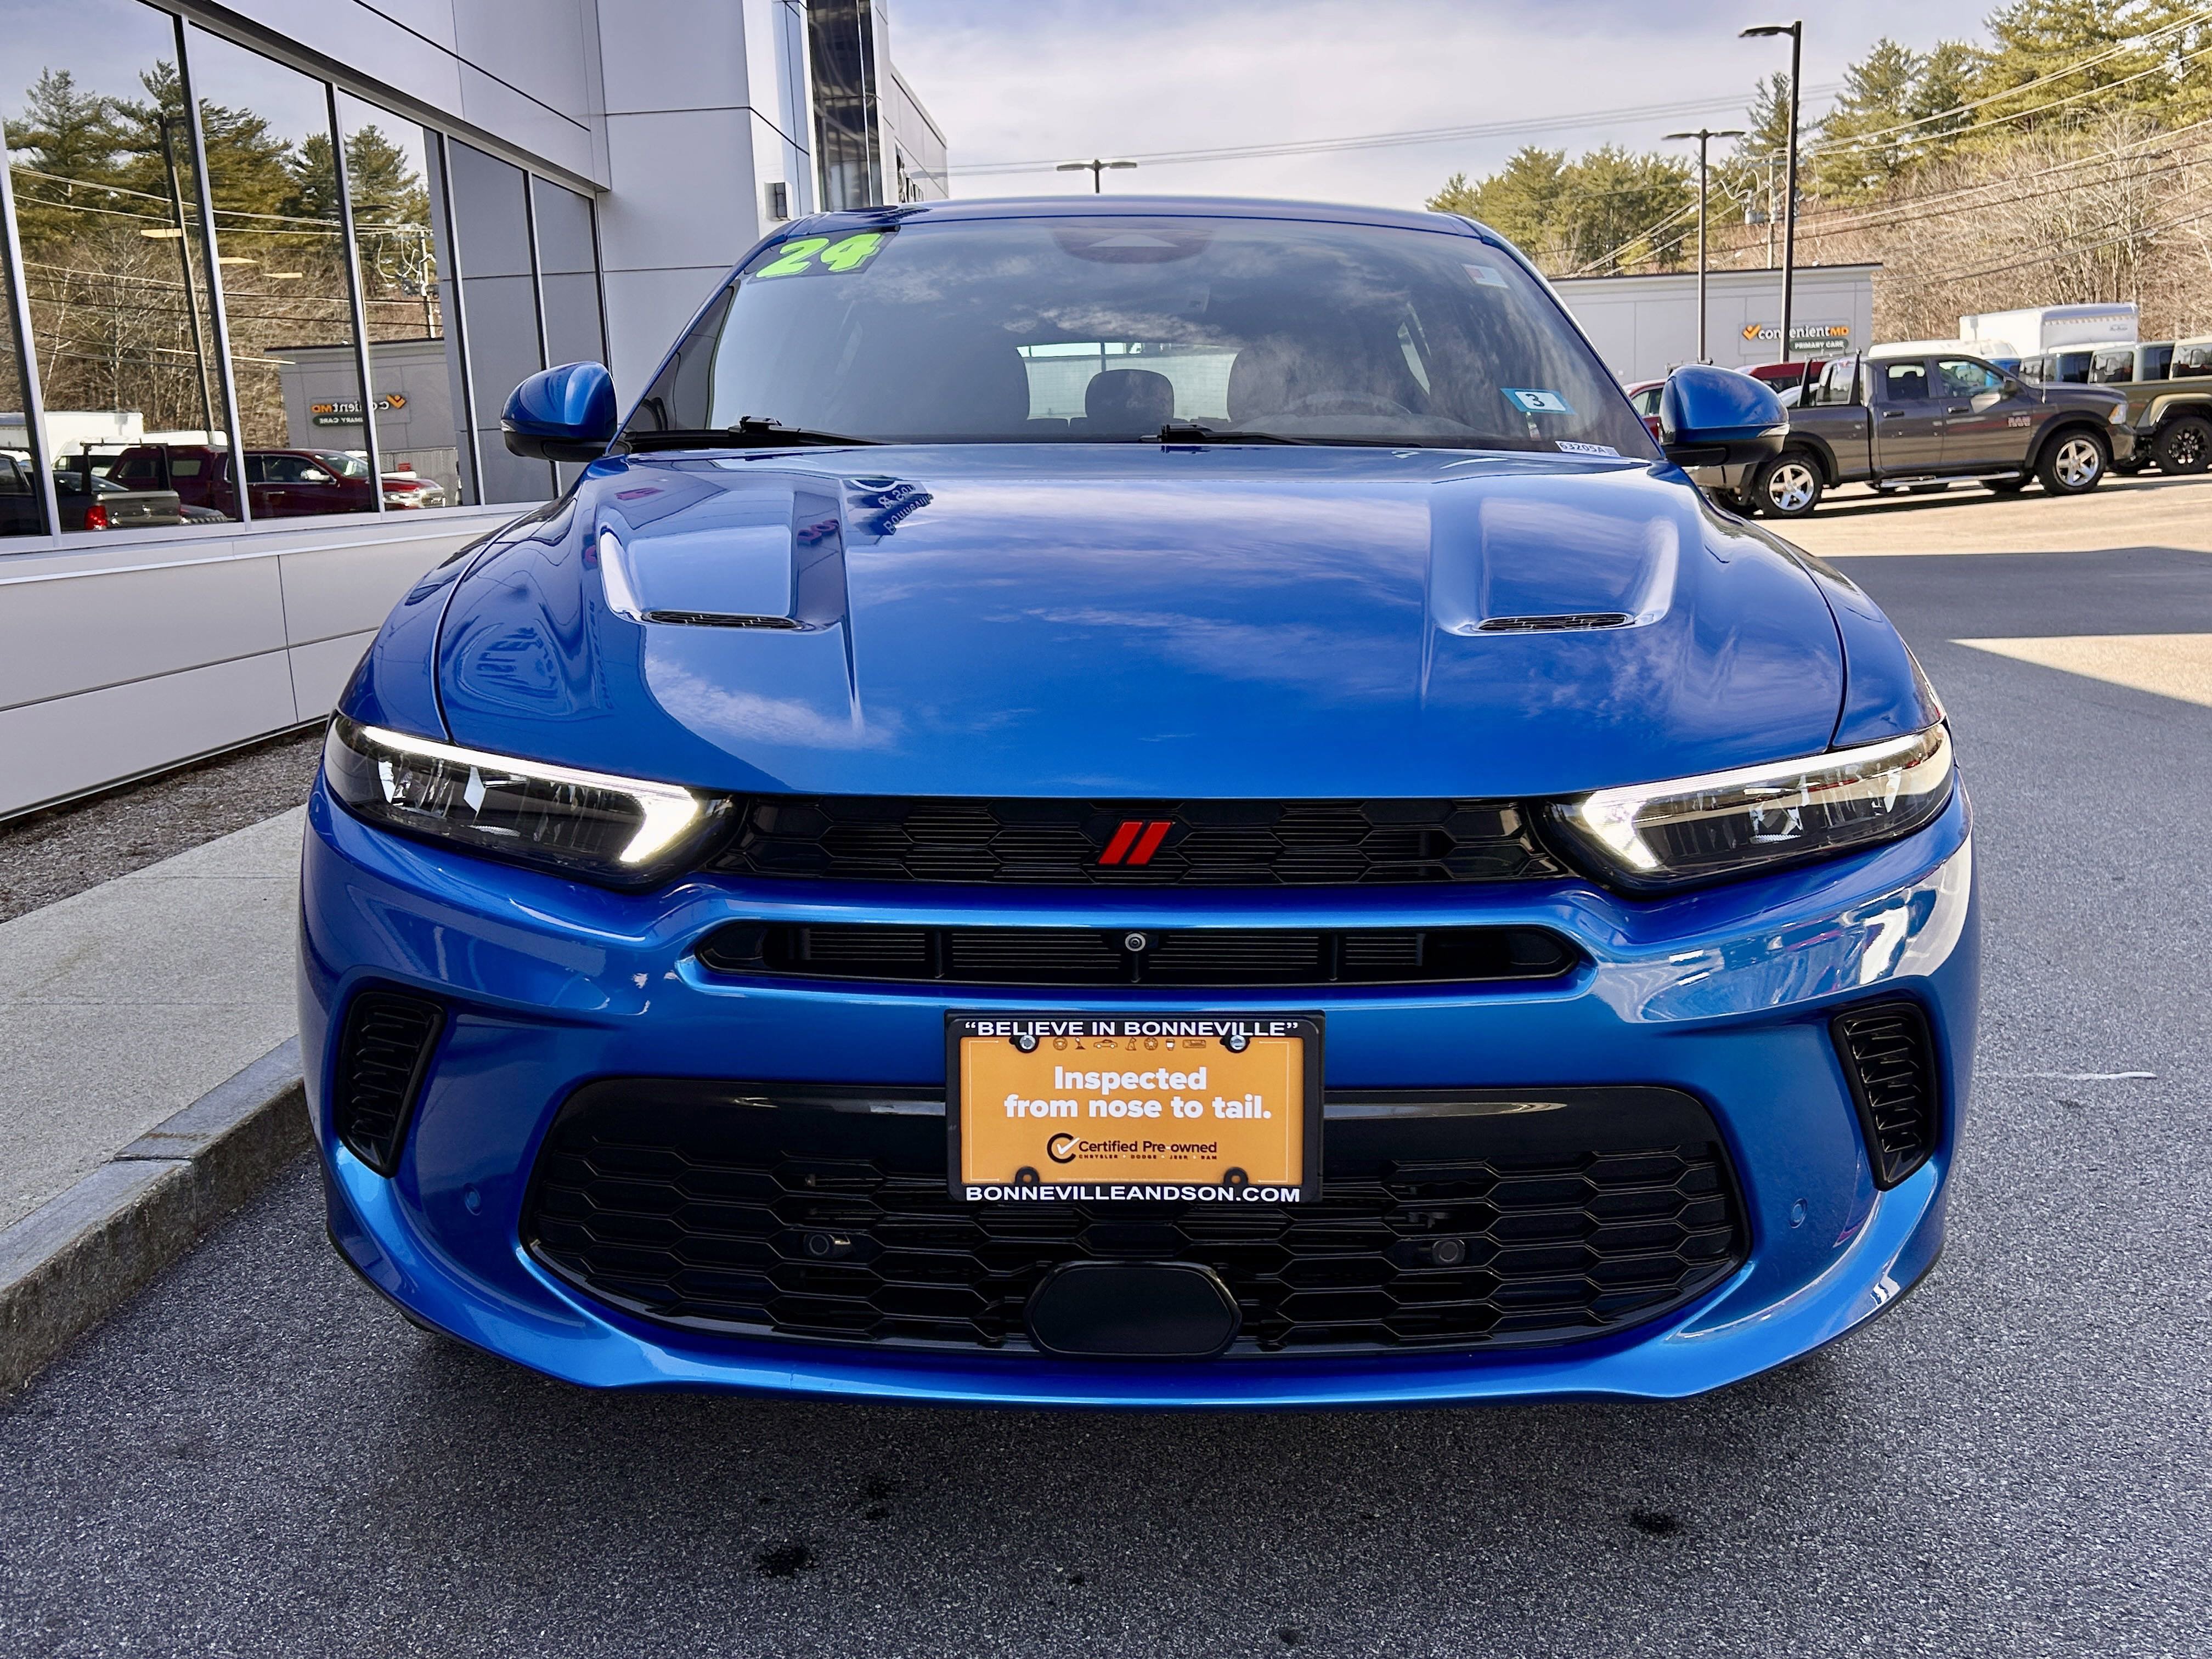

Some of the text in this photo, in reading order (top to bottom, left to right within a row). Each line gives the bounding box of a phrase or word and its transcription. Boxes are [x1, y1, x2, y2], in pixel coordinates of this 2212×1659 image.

[756, 233, 885, 278] 24
[1758, 325, 1849, 340] conenientMD
[1525, 393, 1545, 407] 3
[1559, 442, 1606, 454] 63205A
[1092, 1022, 1115, 1036] IN
[1054, 1065, 1207, 1096] Inspected
[1003, 1093, 1272, 1119] from nose to tail.
[1079, 1141, 1217, 1153] Certified Pre-owned
[966, 1185, 1301, 1203] BONNEVILLEANDSON.COM
